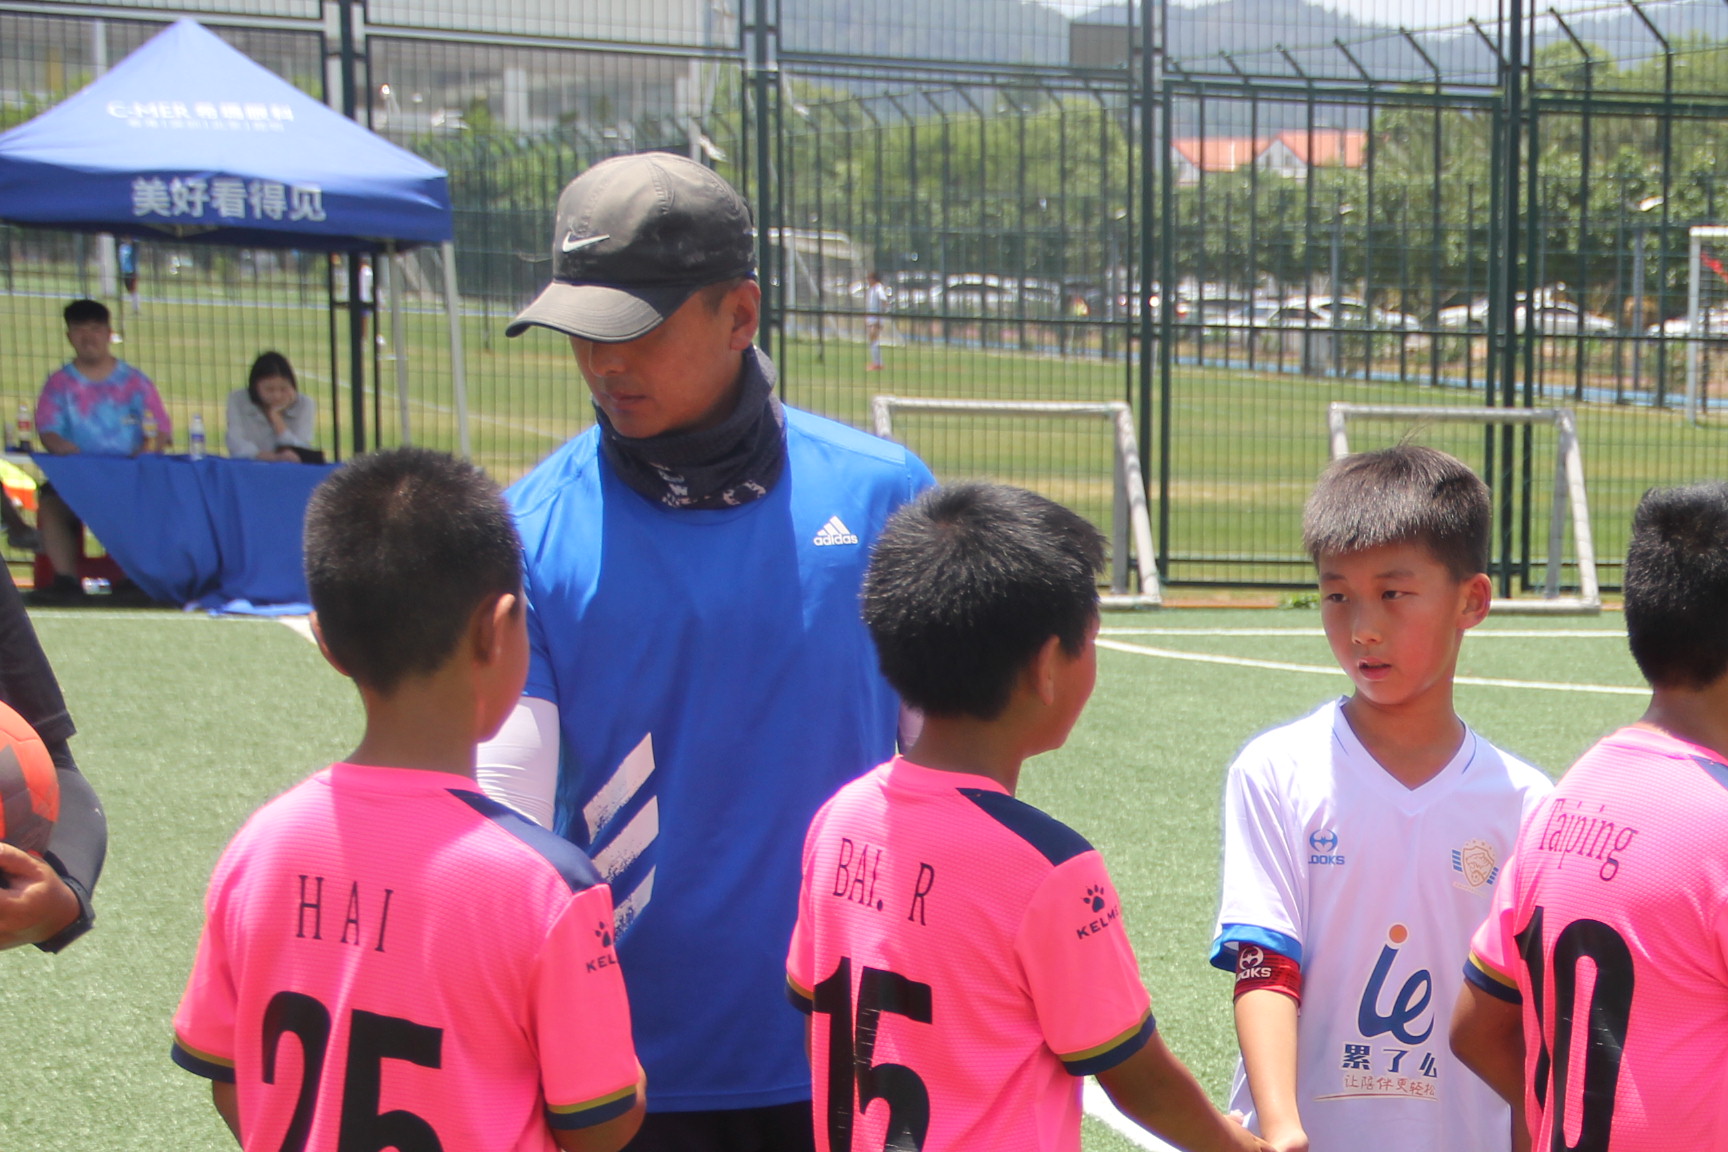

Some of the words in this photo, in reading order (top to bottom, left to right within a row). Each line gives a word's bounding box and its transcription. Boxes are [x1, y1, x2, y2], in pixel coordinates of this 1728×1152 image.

[131, 176, 328, 222] 美好看得见
[813, 533, 858, 546] adidas
[1538, 798, 1639, 881] Taiping
[908, 862, 935, 926] R
[586, 954, 616, 974] KEL
[1342, 1044, 1438, 1079] 累了么
